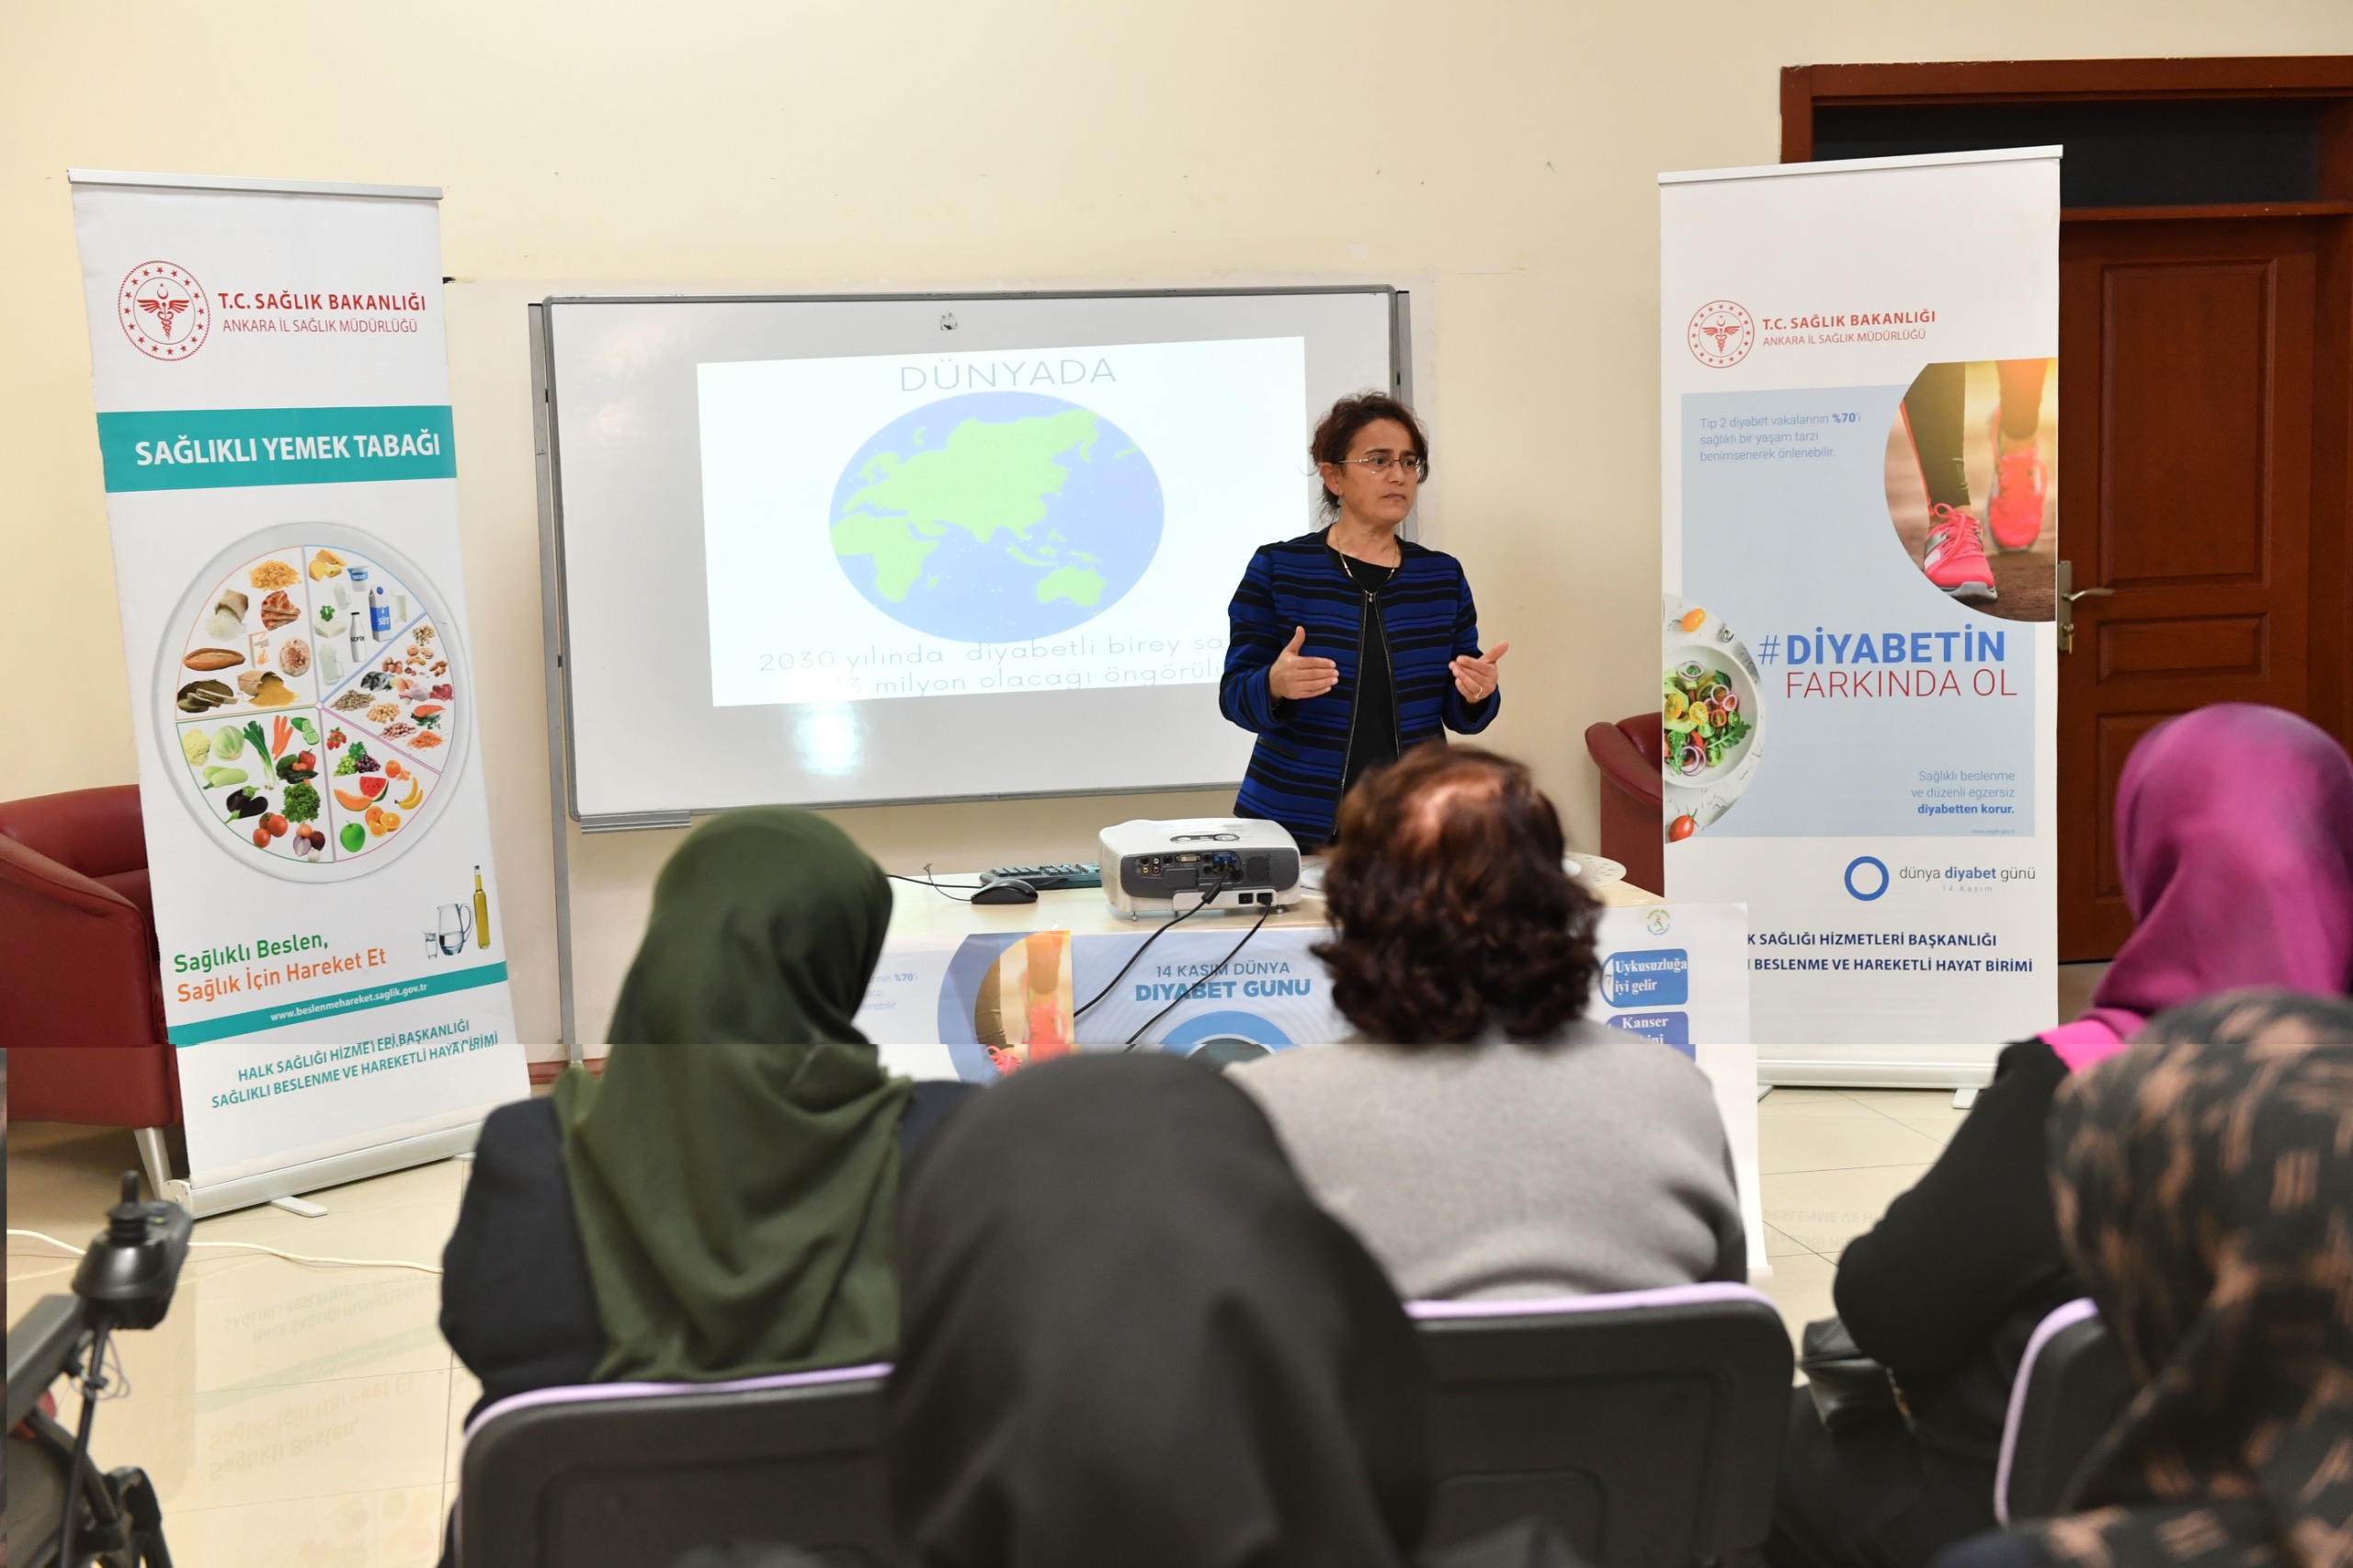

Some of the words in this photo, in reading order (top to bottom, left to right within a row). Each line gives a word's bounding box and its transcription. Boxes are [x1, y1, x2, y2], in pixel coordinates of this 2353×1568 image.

[218, 292, 251, 310] T.C.
[256, 290, 323, 311] SAĞLIK
[329, 291, 426, 311] BAKANLIĞI
[222, 319, 277, 332] ANKARA
[279, 317, 290, 332] İL
[293, 317, 337, 333] SAĞLIK
[340, 318, 418, 333] MÜDÜRLÜĞÜ
[1763, 318, 1787, 330] T.C.
[1790, 314, 1846, 329] SAĞLIK
[1850, 309, 1936, 326] BAKANLIĞI
[1763, 335, 1805, 347] ANKARA
[1808, 334, 1816, 344] İL
[1819, 332, 1855, 344] SAĞLIK
[1858, 328, 1927, 342] MÜDÜRLÜĞÜ
[900, 358, 1117, 392] DÜNYADA
[1700, 418, 1717, 430] Tip
[1720, 417, 1727, 427] 2
[1730, 415, 1768, 429] diyabet
[1771, 415, 1829, 426] vakalarının
[134, 435, 257, 466] SAĞLIKLI
[262, 437, 351, 460] YEMEK
[354, 428, 440, 458] TABAĞI
[1700, 434, 1737, 447] sağlıklı
[1739, 433, 1754, 444] bir
[1756, 432, 1791, 446] yaşam
[1795, 432, 1819, 442] tarzı
[1700, 449, 1775, 461] benimsenerek
[759, 651, 835, 671] 2030
[847, 644, 944, 673] yılında
[966, 635, 1095, 665] diyabetli
[1109, 634, 1180, 657] birey
[1194, 638, 1230, 651] sa
[1757, 623, 2006, 666] #DİYABETİN
[876, 672, 965, 697] milyon
[980, 667, 1091, 689] olacağı
[1787, 669, 1962, 699] FARKINDA
[1973, 668, 2018, 697] OL
[1918, 770, 1957, 783] Sağlıklı
[1961, 770, 2015, 781] beslenme
[1911, 790, 1924, 798] ve
[1927, 787, 1965, 798] düzenli
[1969, 789, 2015, 800] egzersiz
[1917, 803, 1978, 816] diyabetten
[1981, 803, 2015, 814] korur.
[1899, 866, 1940, 882] dünya
[1945, 866, 1996, 882] diyabet
[2000, 867, 2036, 882] günü
[1759, 931, 1815, 946] SAĞLIĞI
[1820, 931, 1904, 946] HİZMETLERİ
[1908, 932, 1996, 949] BAŞKANLIĞI
[174, 944, 251, 972] Sağlıklı
[256, 934, 328, 959] Beslen,
[1156, 966, 1172, 978] 14
[1177, 963, 1228, 977] KASIM
[1233, 960, 1290, 975] DÜNYA
[1615, 958, 1688, 976] Uykusuzluğa
[1755, 959, 1829, 971] BESLENME
[1832, 959, 1850, 971] VE
[1854, 957, 1932, 971] HAREKETLİ
[1936, 960, 1982, 971] HAYAT
[1985, 958, 2033, 972] BİRİMİ
[177, 975, 241, 1003] Sağlık
[246, 967, 280, 990] İçin
[287, 952, 362, 982] Hareket
[367, 948, 386, 966] Et
[1615, 980, 1629, 995] iyi
[1631, 979, 1657, 994] gelir
[270, 983, 427, 1021] www.beslenmehareket.saglik.gov.tr
[1622, 1017, 1668, 1029] Kanser
[238, 1063, 274, 1082] HALK
[277, 1051, 327, 1074] SAĞLIĞI
[399, 1018, 470, 1044] BAŞKANLIĞI
[211, 1085, 270, 1108] SAĞLIKLI
[274, 1069, 340, 1095] BESLENME
[343, 1065, 358, 1079] VE
[361, 1048, 426, 1074] HAREKETLİ
